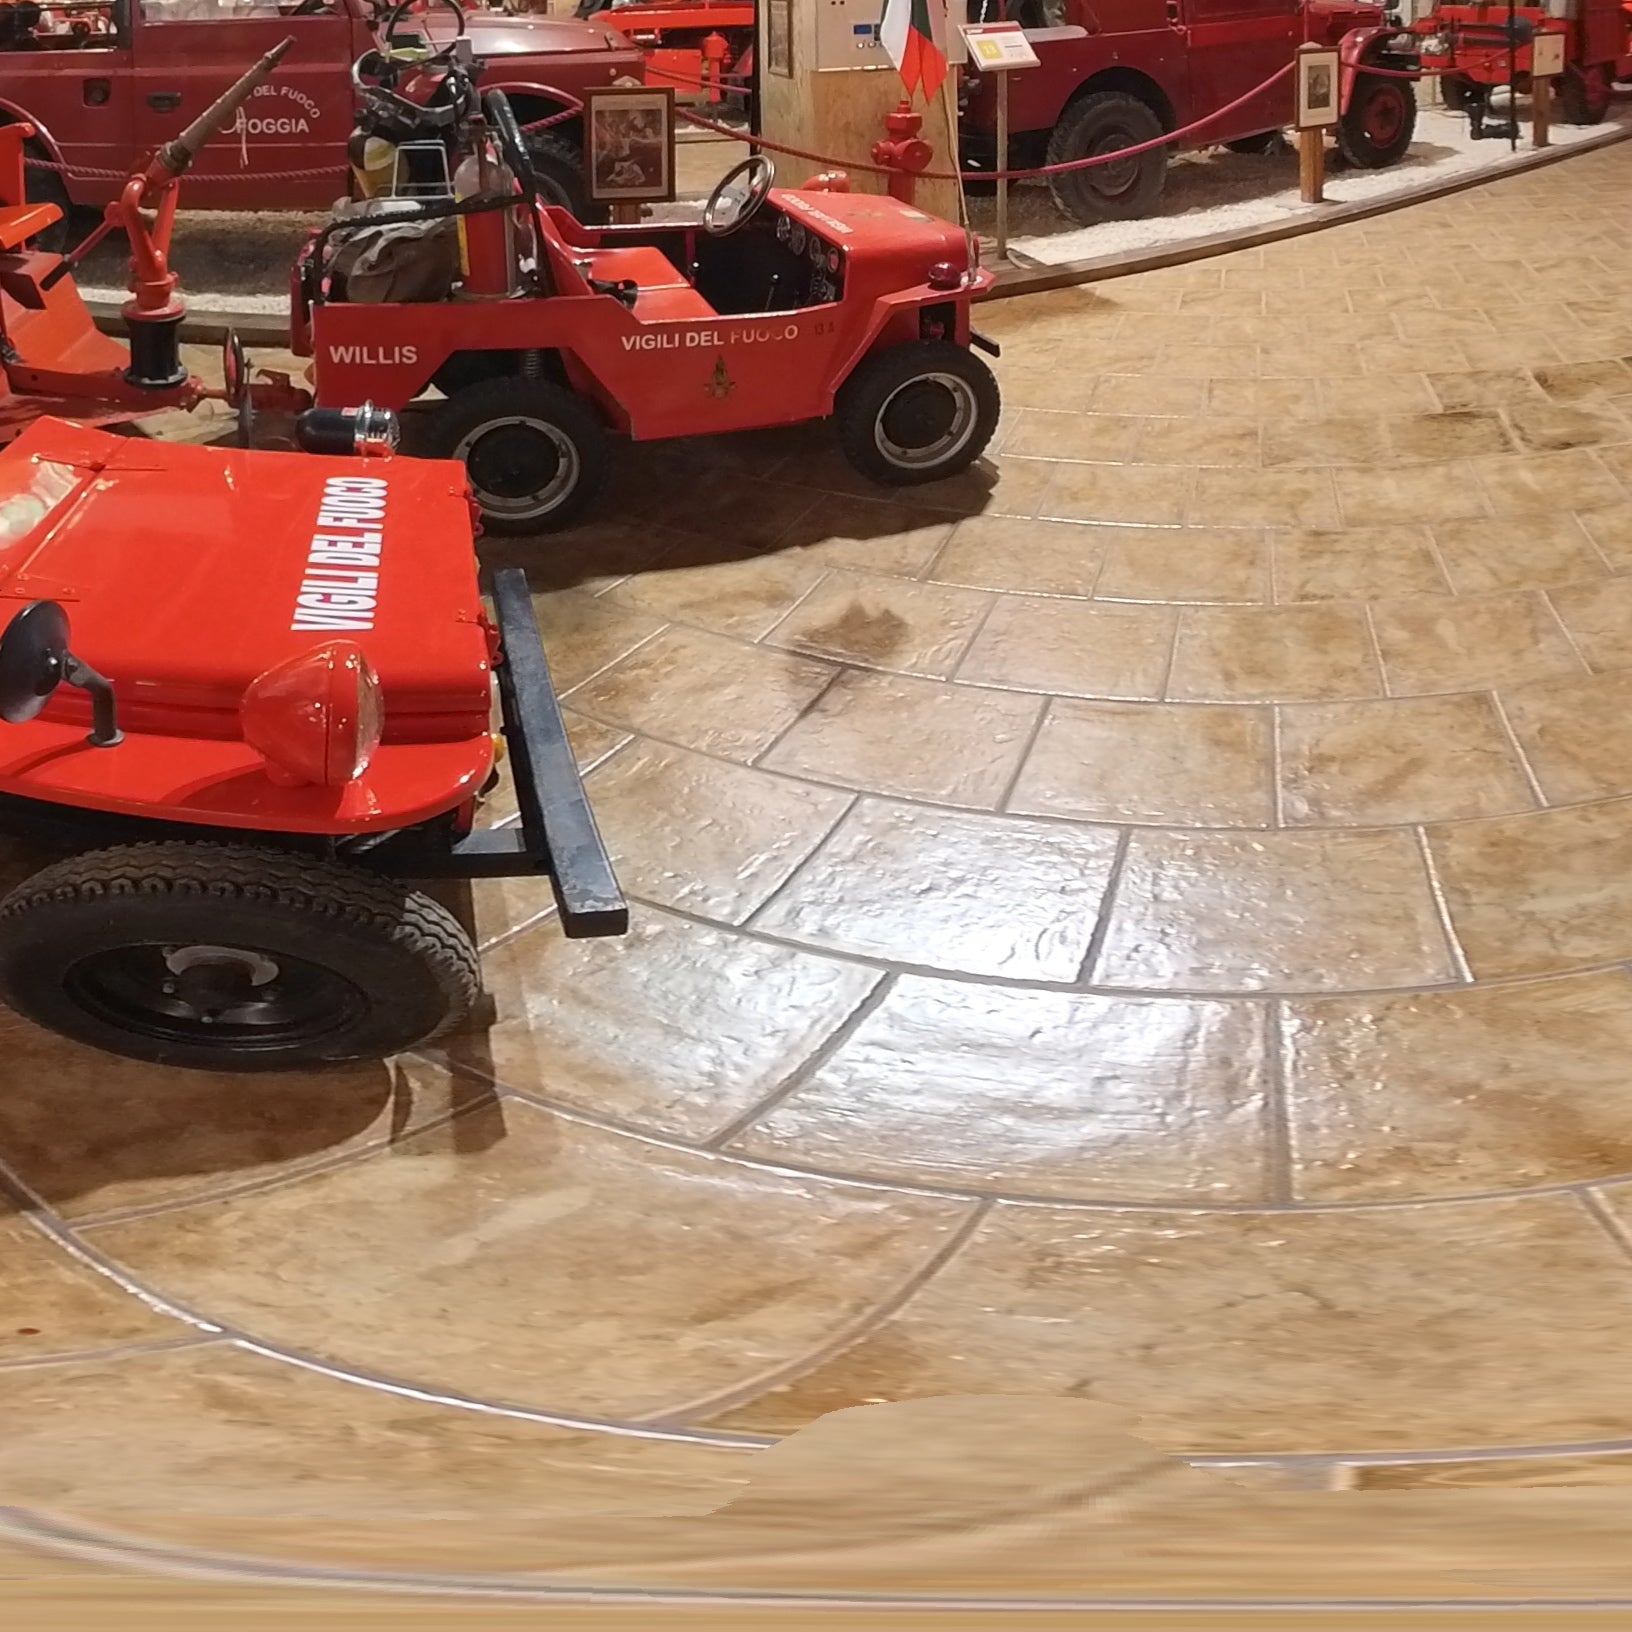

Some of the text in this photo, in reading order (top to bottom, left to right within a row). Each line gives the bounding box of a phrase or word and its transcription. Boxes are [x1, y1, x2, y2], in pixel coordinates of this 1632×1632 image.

[253, 85, 321, 118] DEL FUOCO
[236, 118, 310, 134] FOGGIA
[621, 324, 799, 352] VIGILI DEL FUOCO
[328, 345, 418, 365] WILLIS
[290, 476, 388, 631] VIGILI DEL FUOCO
